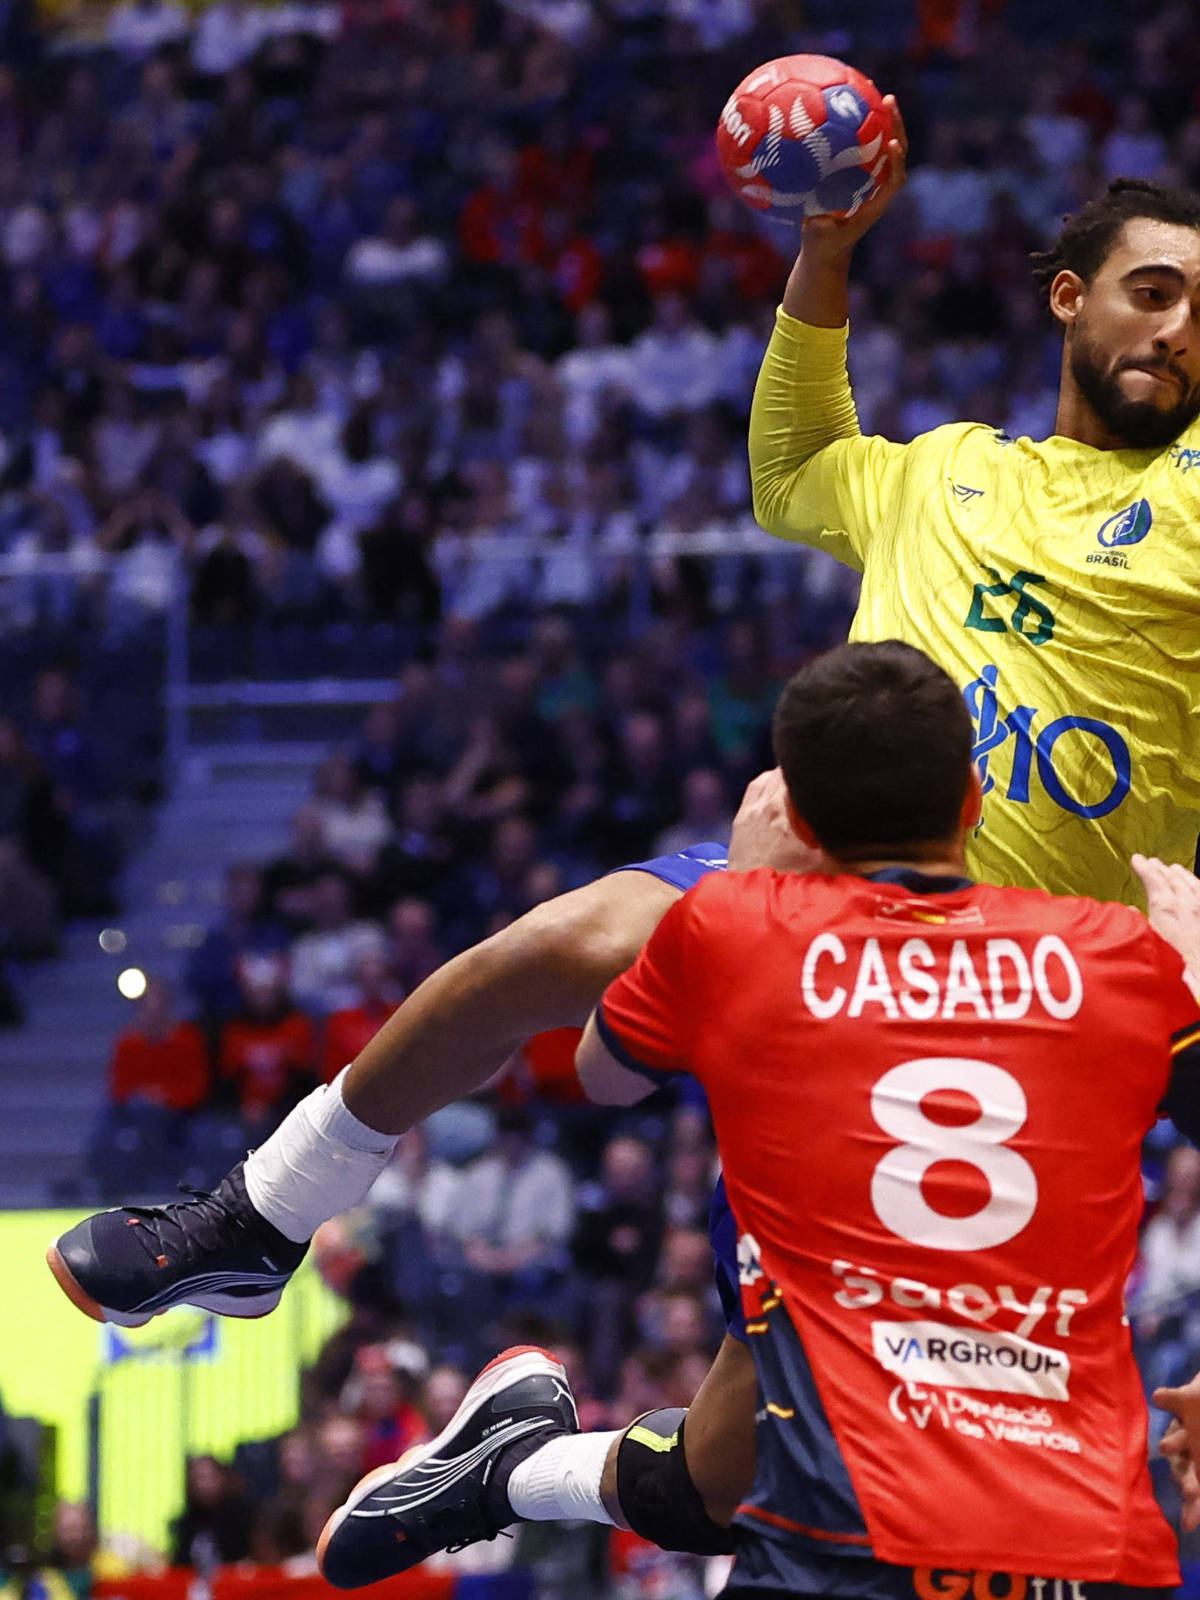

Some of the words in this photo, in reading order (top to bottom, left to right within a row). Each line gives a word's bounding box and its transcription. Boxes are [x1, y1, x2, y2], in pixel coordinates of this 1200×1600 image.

[1085, 554, 1131, 570] BRASIL
[964, 563, 1056, 646] 26
[801, 932, 1084, 1021] CASADO
[870, 1056, 1039, 1251] 8
[885, 1337, 1062, 1374] VARGROUP
